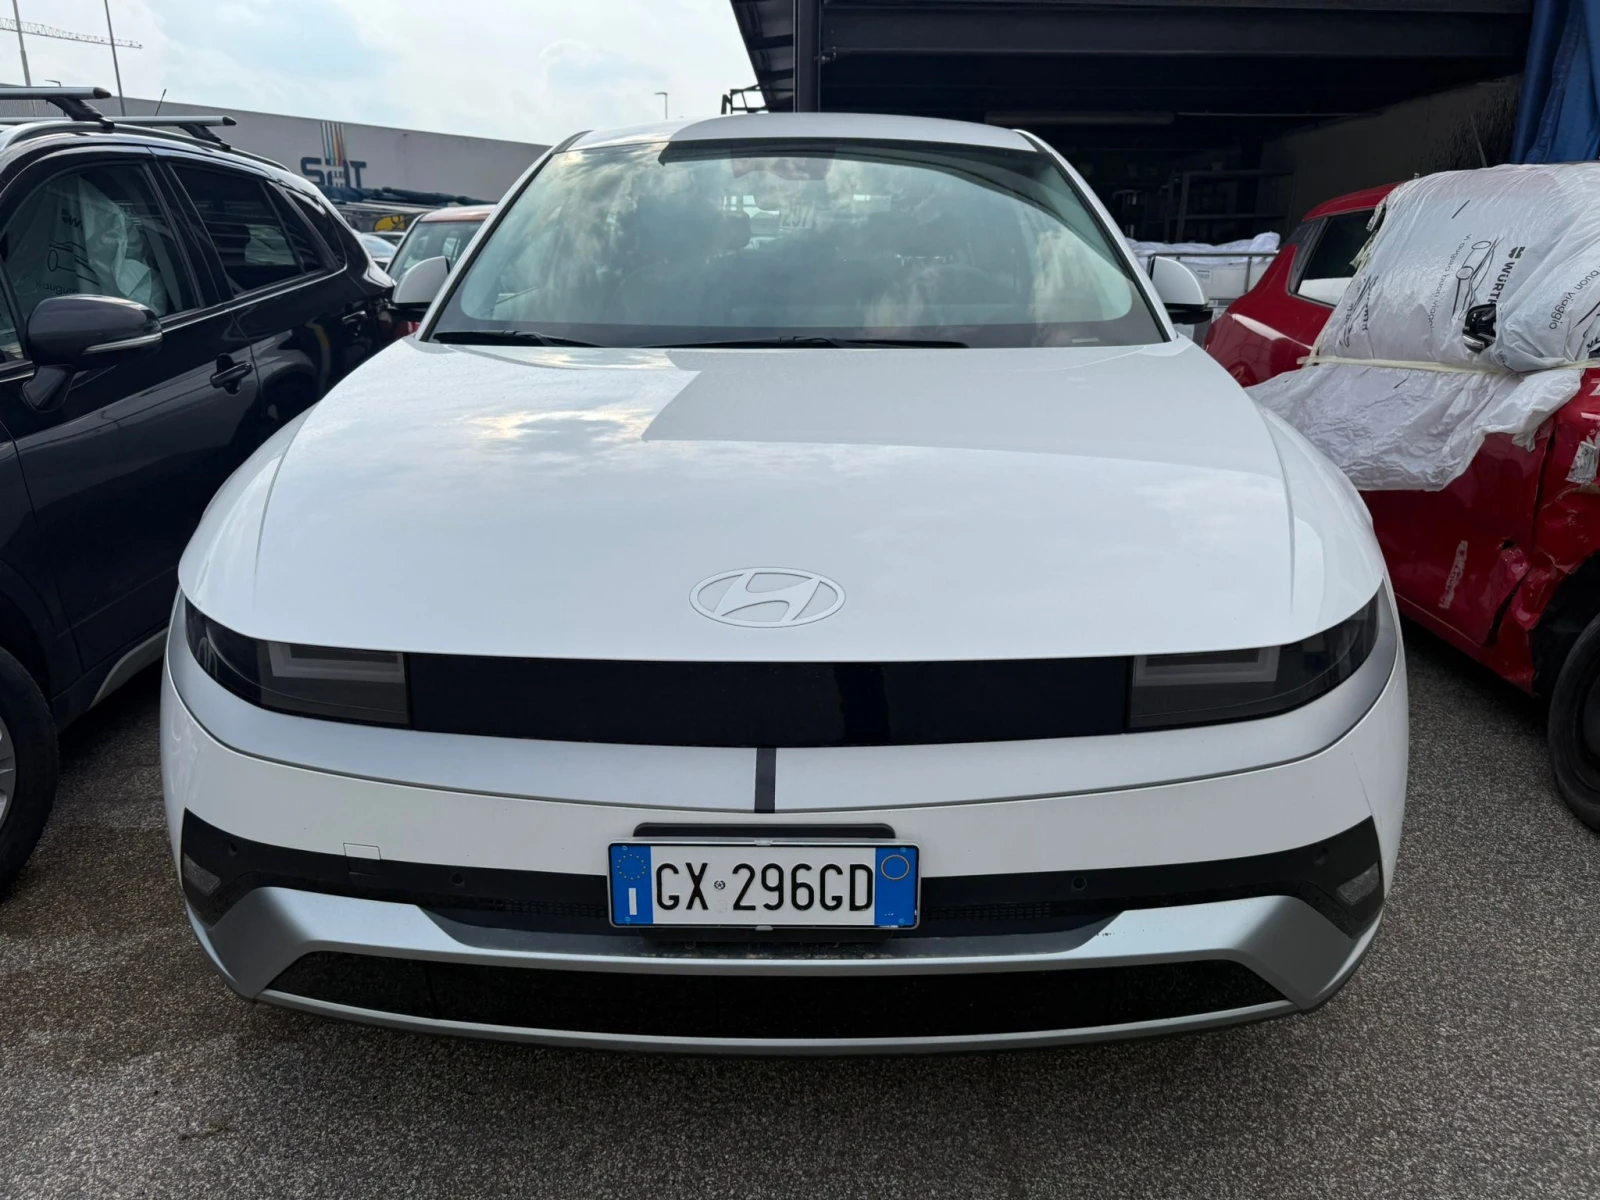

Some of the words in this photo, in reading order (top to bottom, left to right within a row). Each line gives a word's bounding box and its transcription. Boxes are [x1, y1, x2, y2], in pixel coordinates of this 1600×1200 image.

[1435, 273, 1450, 298] buon
[1549, 291, 1575, 329] viaggio
[655, 862, 709, 911] GX
[731, 862, 874, 912] 296GD
